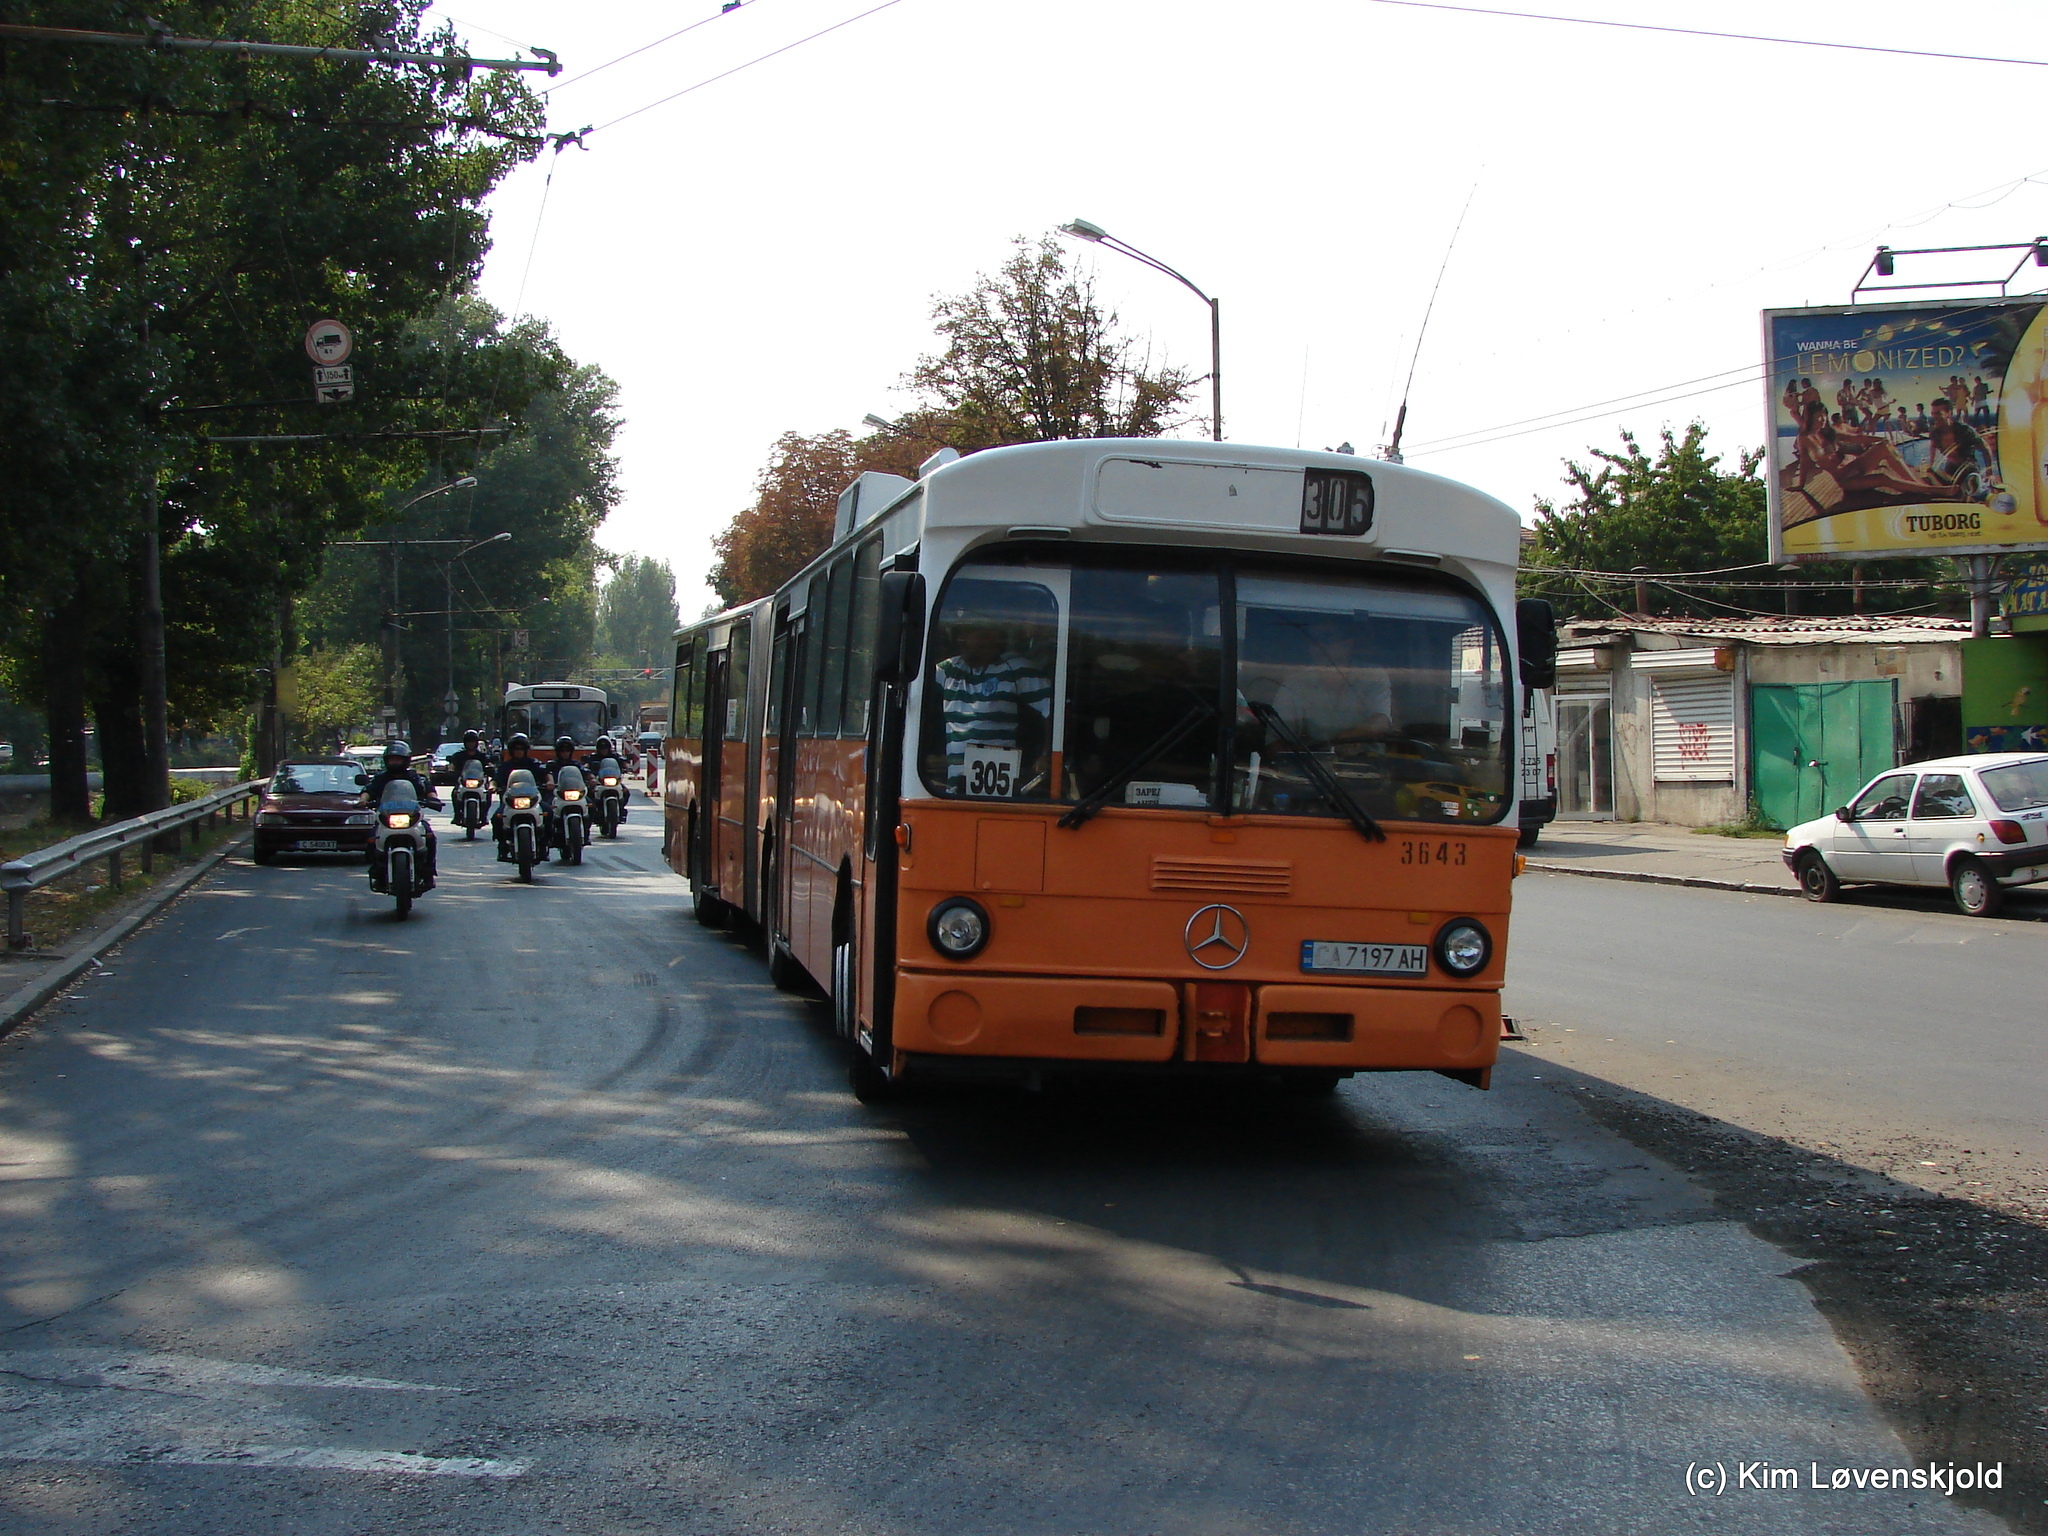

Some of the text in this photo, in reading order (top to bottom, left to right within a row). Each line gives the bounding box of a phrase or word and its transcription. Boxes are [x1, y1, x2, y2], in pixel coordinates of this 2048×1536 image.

[1796, 340, 1858, 351] WANNA BE
[1796, 346, 1965, 375] LEMONIZED?
[1306, 479, 1368, 528] 305
[1906, 513, 1981, 532] TUBORG
[970, 761, 1011, 795] 305
[1401, 841, 1466, 865] 3643
